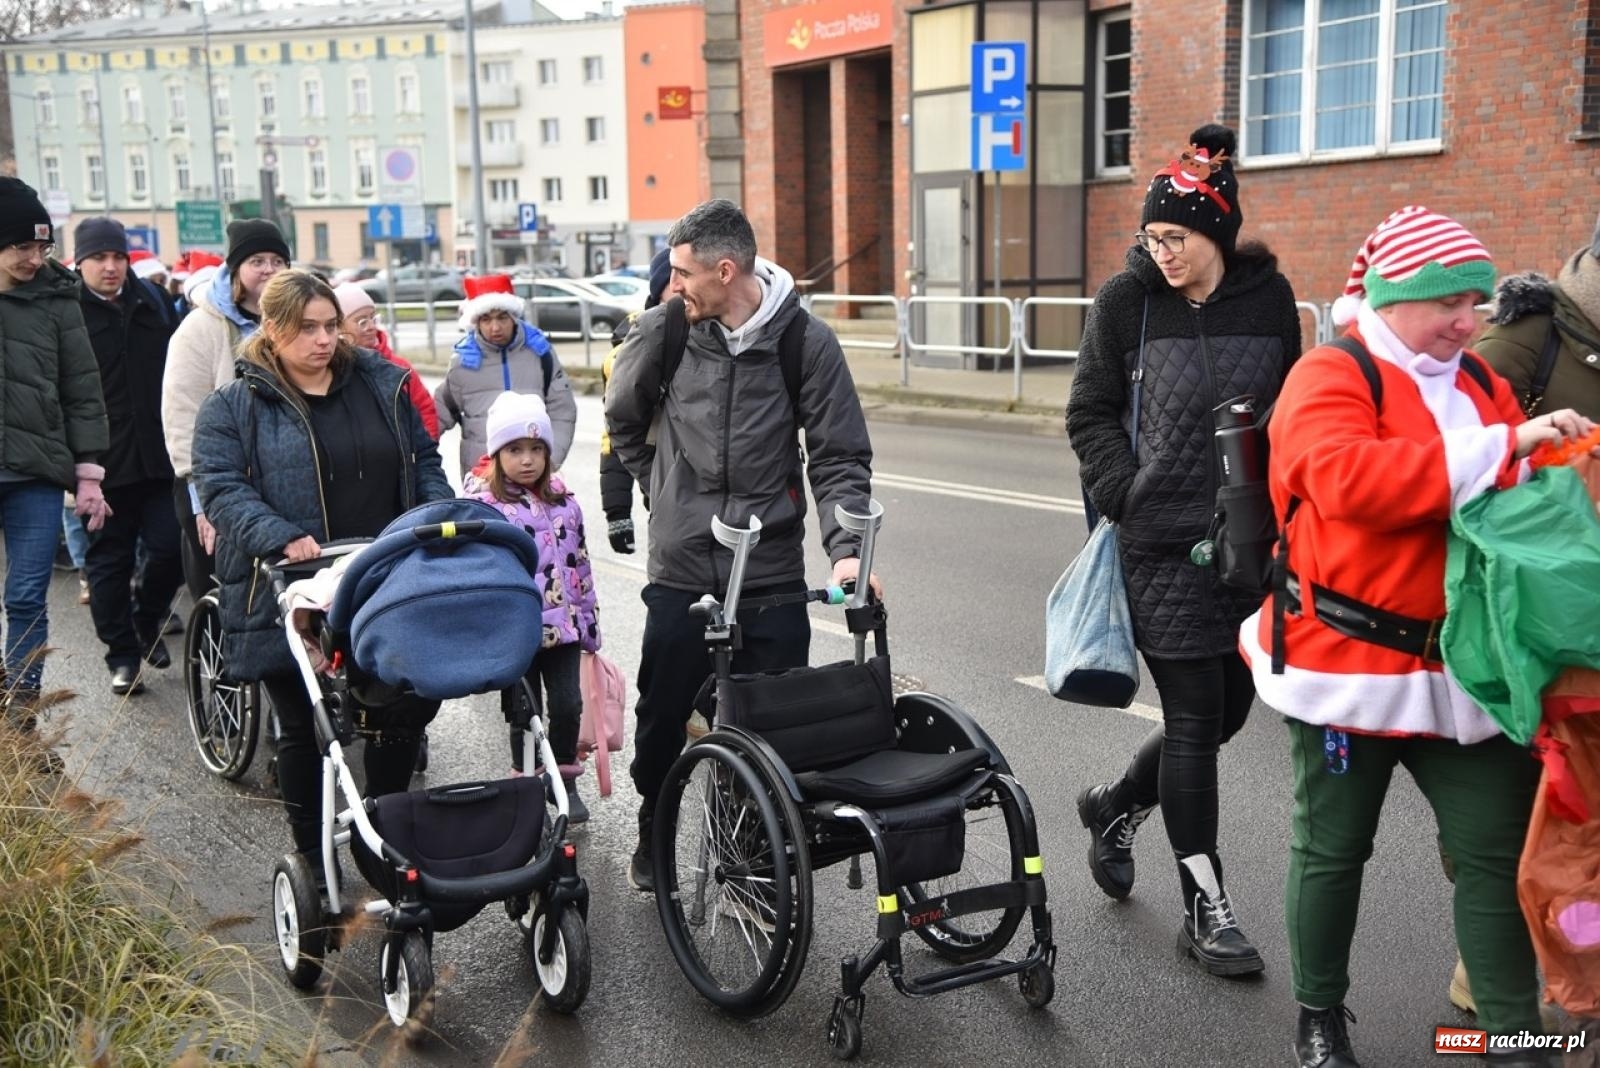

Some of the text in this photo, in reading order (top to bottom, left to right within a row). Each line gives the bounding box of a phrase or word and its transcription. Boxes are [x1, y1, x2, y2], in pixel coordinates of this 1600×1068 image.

[814, 11, 880, 40] Poczta Polska
[983, 48, 1016, 94] P
[522, 205, 535, 230] P
